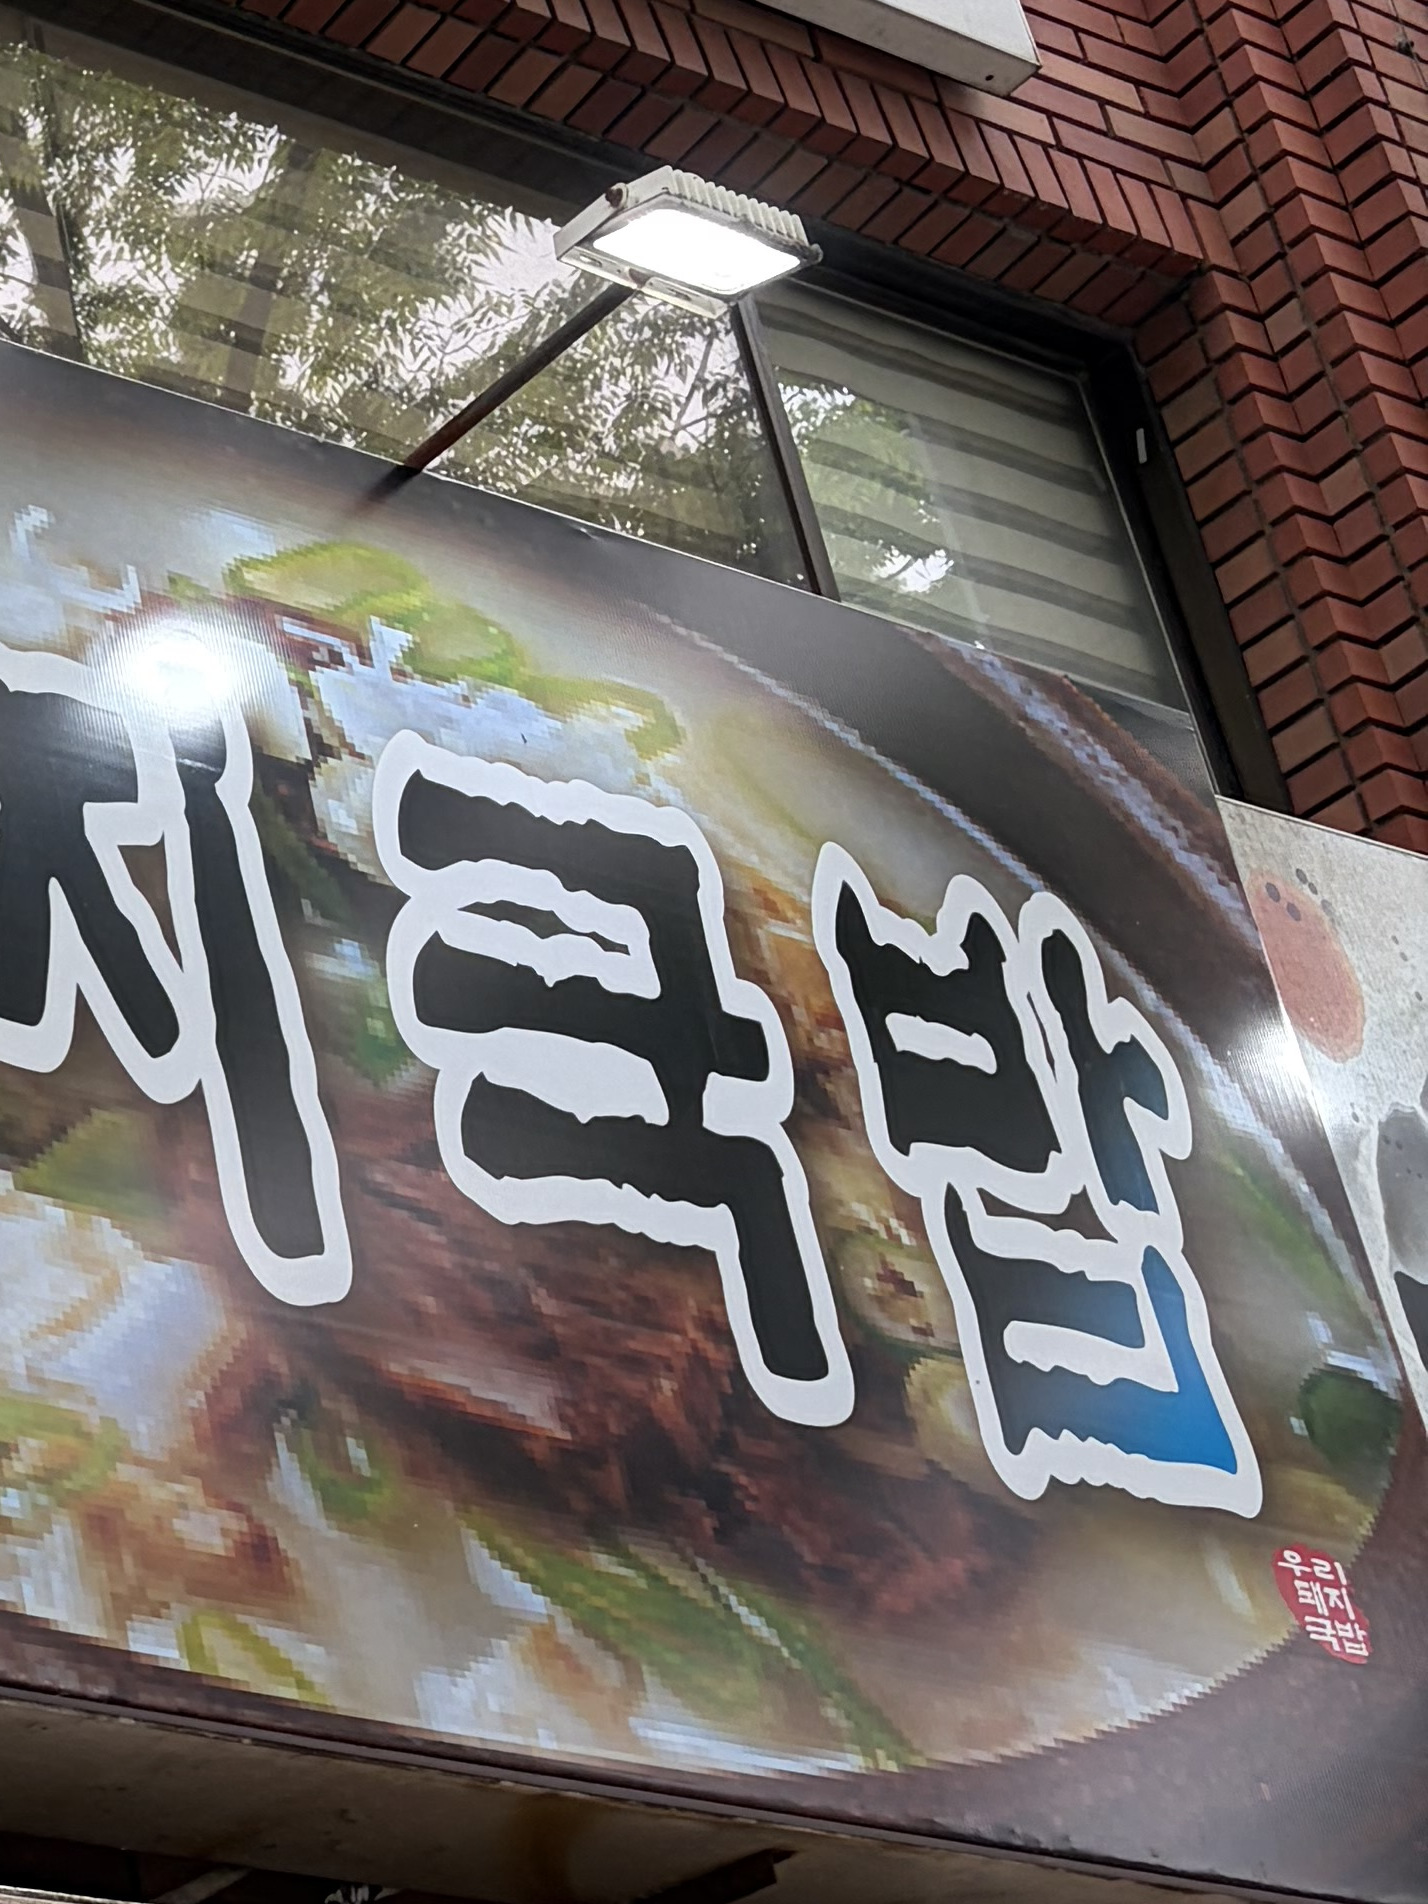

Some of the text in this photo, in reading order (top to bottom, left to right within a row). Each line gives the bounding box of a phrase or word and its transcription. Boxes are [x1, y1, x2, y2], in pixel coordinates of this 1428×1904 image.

[1277, 1549, 1348, 1586] 우리
[1294, 1580, 1356, 1621] 돼지
[1304, 1615, 1369, 1657] 국밥
